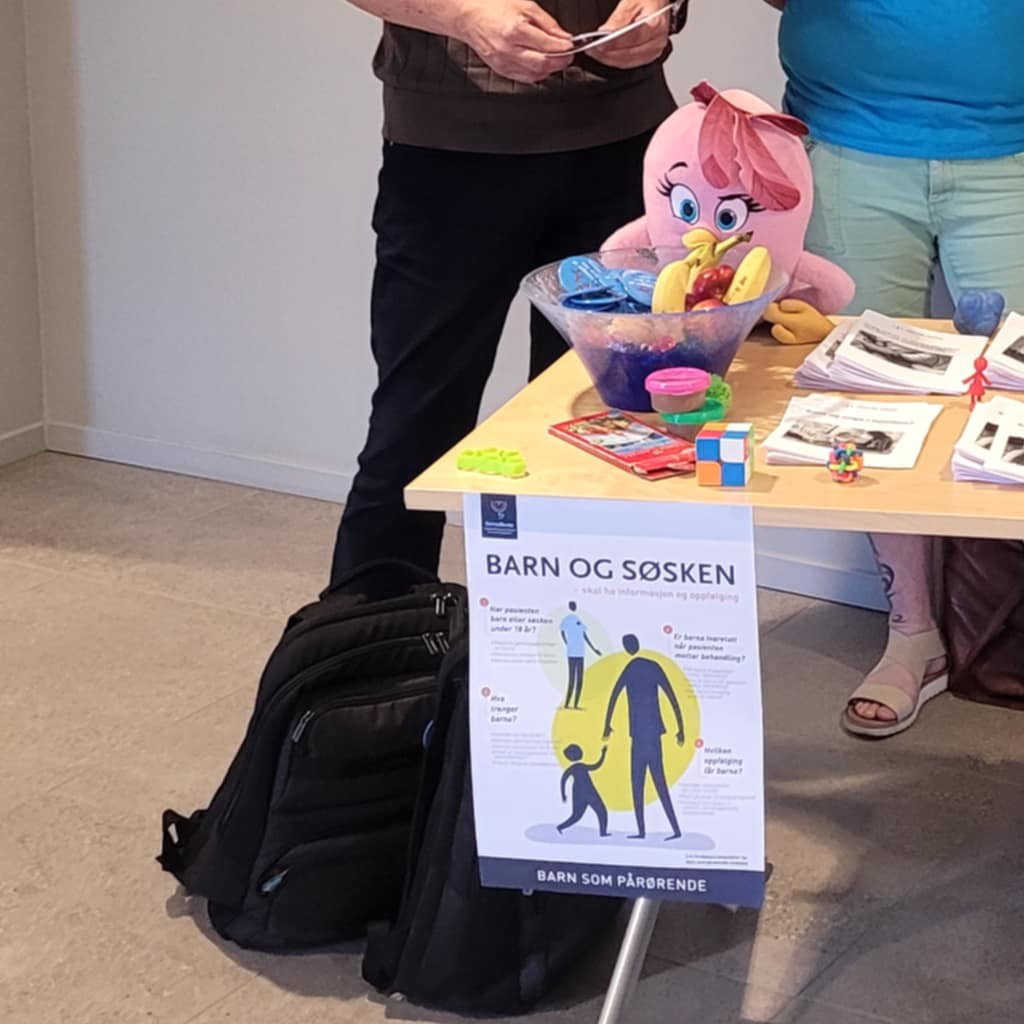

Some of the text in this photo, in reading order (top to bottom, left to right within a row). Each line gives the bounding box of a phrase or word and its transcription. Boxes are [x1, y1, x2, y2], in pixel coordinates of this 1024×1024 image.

[486, 554, 736, 585] BARN OG SØSKEN
[537, 870, 707, 892] BARN SOM PÅRØRENDE
